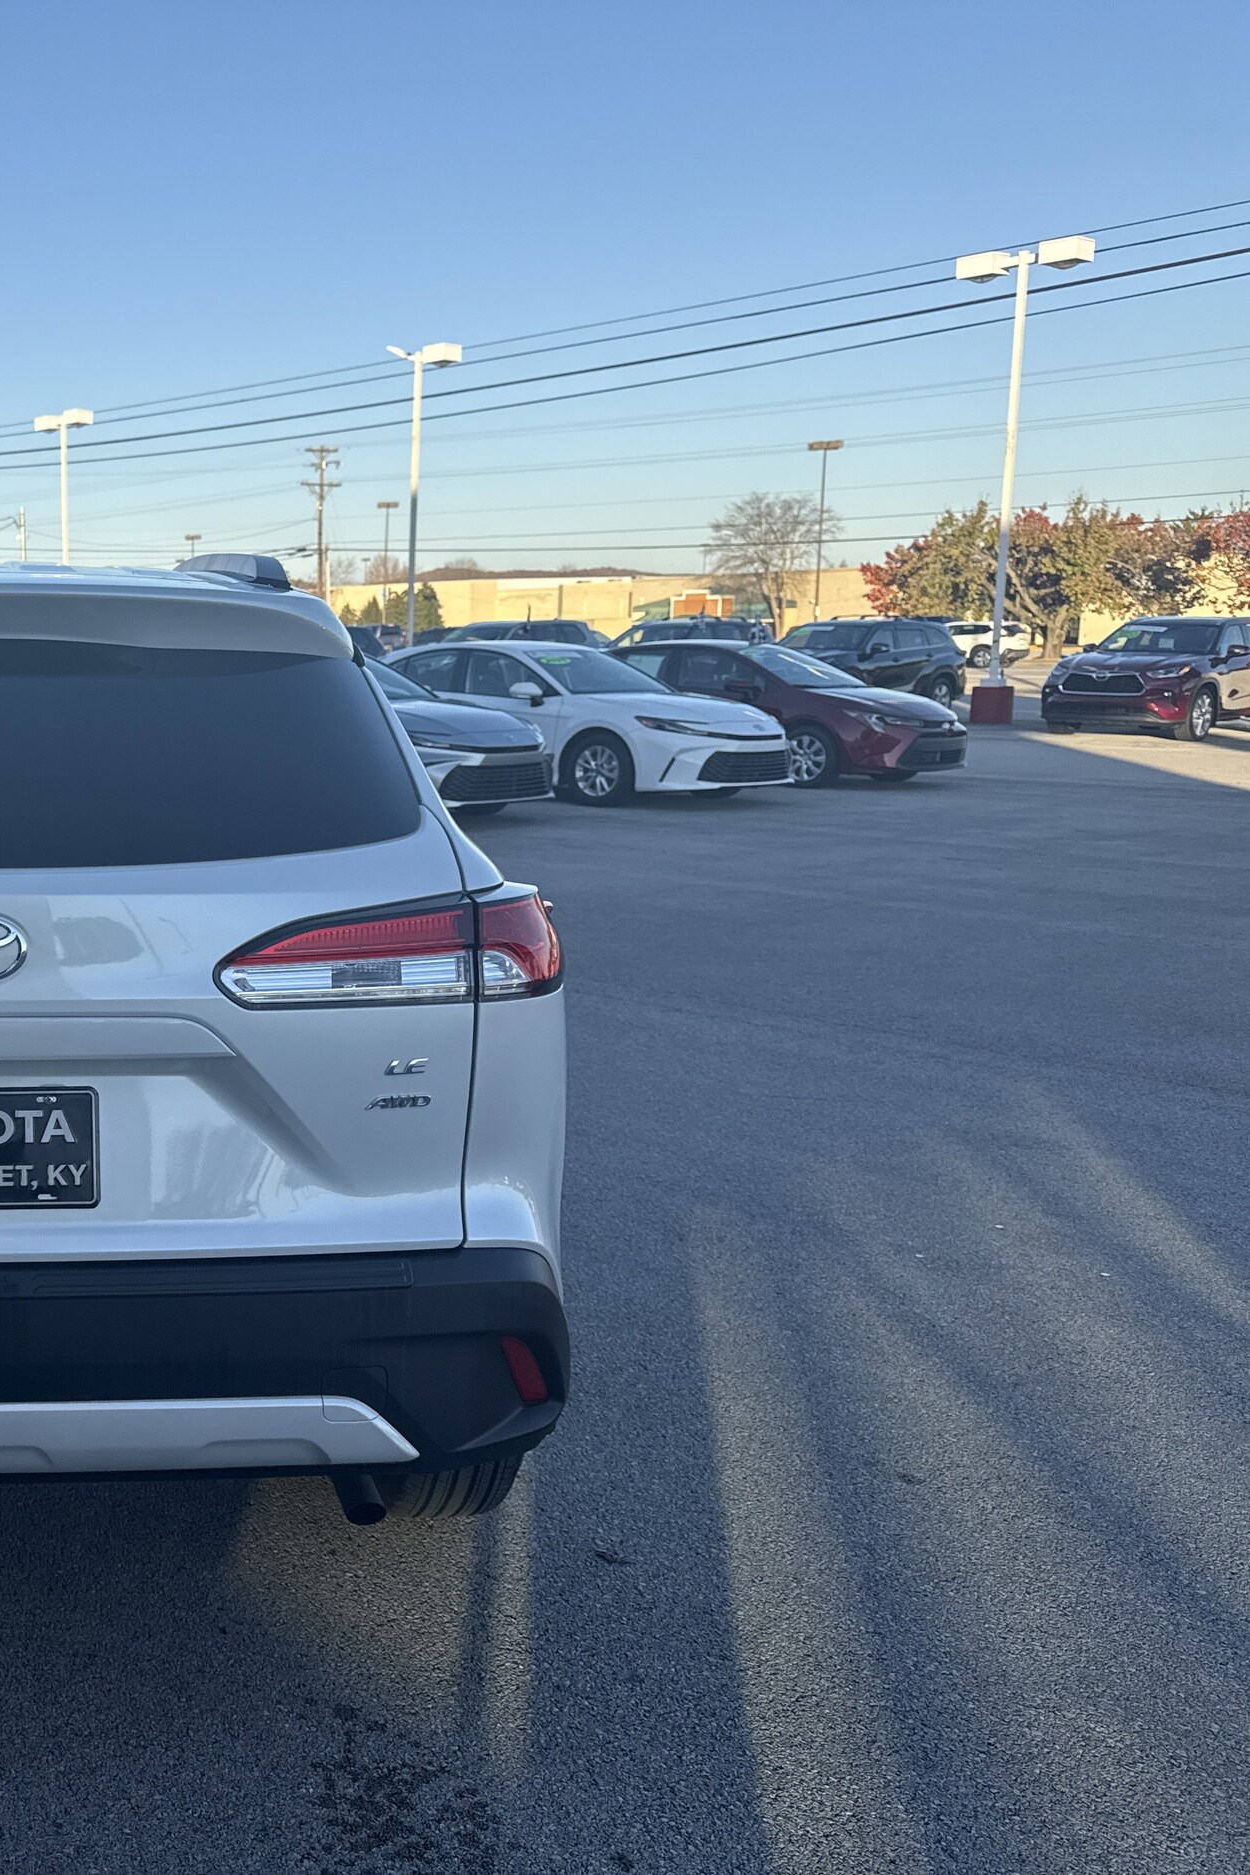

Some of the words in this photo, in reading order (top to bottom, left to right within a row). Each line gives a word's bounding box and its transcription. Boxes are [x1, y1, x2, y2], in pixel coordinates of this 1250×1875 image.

[384, 1057, 430, 1076] LE
[365, 1094, 431, 1110] AWD
[47, 1164, 87, 1186] KY
